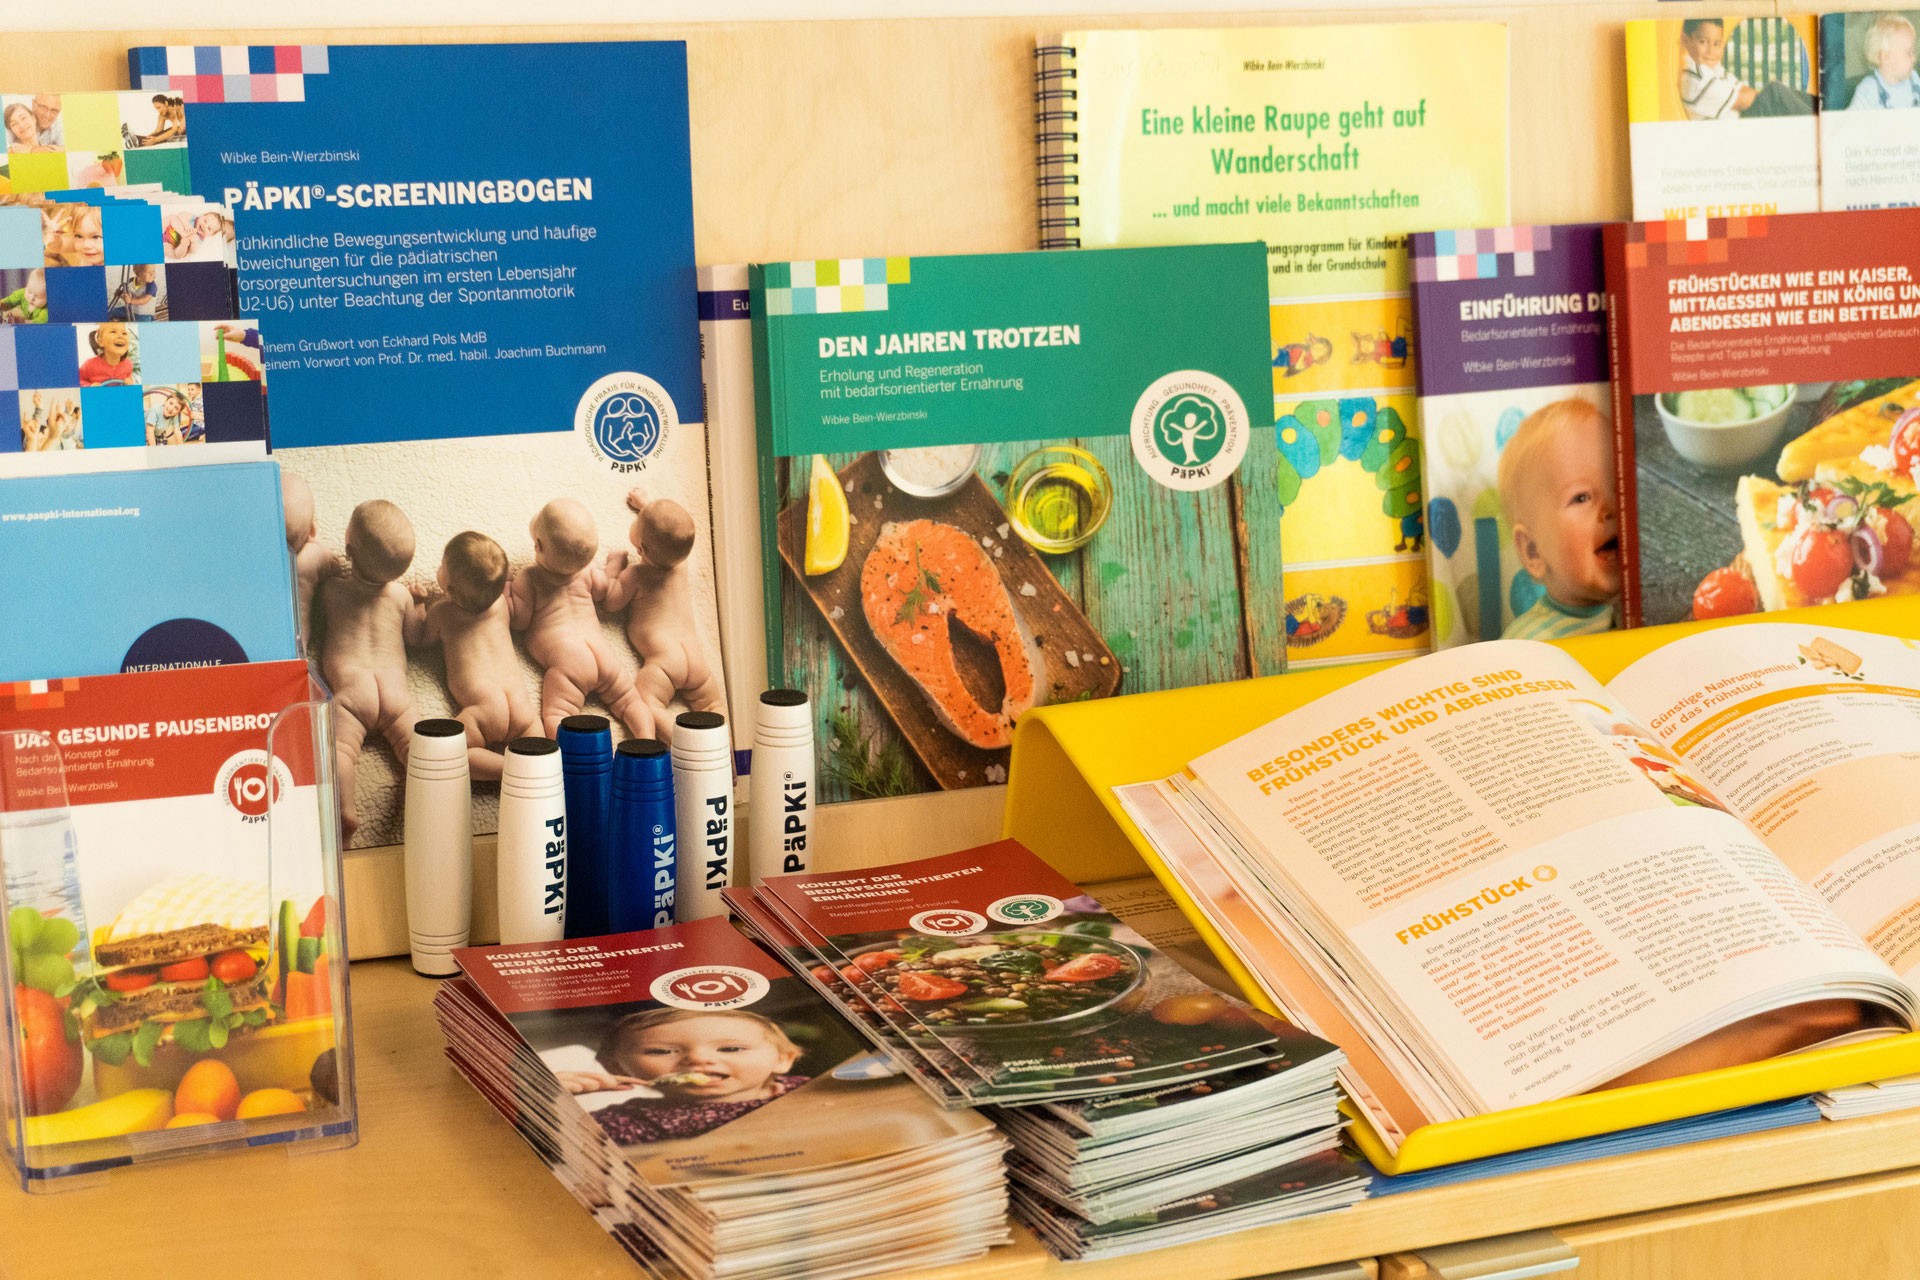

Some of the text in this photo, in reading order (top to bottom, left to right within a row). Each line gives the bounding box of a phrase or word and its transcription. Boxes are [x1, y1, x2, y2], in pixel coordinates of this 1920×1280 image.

[1142, 99, 1425, 138] Eine kleine Raupe geht auf
[220, 150, 360, 164] Wibke Bein-Wierzbinski
[1211, 142, 1360, 175] Wanderschaft
[224, 177, 593, 211] PÄPKI®-SCREENINGBOGEN
[1173, 198, 1200, 217] und
[1206, 196, 1249, 215] macht
[1256, 194, 1291, 213] viele
[1298, 189, 1419, 212] Bekanntschaften
[236, 225, 596, 251] rühkindliche Bewegungsentwicklung und häufige
[1263, 237, 1397, 258] ungsprogramm für Kinder
[236, 248, 497, 273] bweichungen für die pädiatrischen
[1273, 256, 1386, 274] und in der Grundschule
[424, 271, 441, 283] im
[447, 269, 492, 282] ersten
[498, 265, 576, 281] Lebensjahr
[1668, 266, 1912, 294] FRÜHSTÜCKEN WIE EIN KAISER,
[239, 284, 575, 313] U2-U6) unter Beachtung der Spontanmotorik
[732, 299, 750, 311] Eu
[1460, 293, 1583, 321] EINFÜHRUNG
[1669, 292, 1776, 313] MITTAGESSEN
[1779, 290, 1809, 306] WIE
[1813, 288, 1839, 305] EIN
[1843, 285, 1895, 303] KÖNIG
[1670, 312, 1772, 332] ABENDESSEN
[1776, 310, 1804, 326] WIE
[1808, 308, 1834, 324] EIN
[262, 332, 488, 353] einem Grußwort von Eckhard Pols MdB
[819, 324, 1081, 358] DEN JAHREN TROTZEN
[264, 345, 605, 371] einem Vorwort von Prof. Dr. med. habil. Joachim Buchmann
[820, 362, 984, 385] Erholung und Regeneration
[594, 384, 619, 403] PRAXIS
[620, 381, 635, 390] FÜR
[820, 376, 1024, 399] mit bedarfsorientierter Ernährung
[821, 410, 928, 425] Wibke Bein-Wierzbinski
[1142, 382, 1237, 459] AUFRICHTUNG GESUNDHEIT PRÄVENTION
[2, 507, 141, 522] www.paepki-international.org
[1650, 688, 1704, 729] Günstige
[1704, 663, 1799, 694] Nahrungsmittel
[1658, 679, 1766, 740] für das Frühstück
[57, 722, 151, 746] GESUNDE
[1245, 669, 1523, 784] BESONDERS WICHTIG SIND
[1257, 679, 1577, 797] FRÜHSTÜCK UND ABENDESSEN
[1678, 709, 1741, 751] Nahrungsmittel
[15, 754, 39, 764] Nach
[64, 749, 102, 761] Konzept
[105, 748, 121, 757] der
[16, 757, 155, 777] Bedarfsoentierten Ernährung
[17, 780, 119, 798] Wibke Bei-Wierzbinski
[783, 771, 807, 873] PäPKi®
[1755, 807, 1781, 831] Wiener
[1762, 808, 1800, 838] Leberkäse
[544, 815, 565, 924] PäPKi®
[797, 873, 902, 890] KONZEPT DER
[803, 865, 984, 896] BEDARFSORIENTIERTEN
[1813, 871, 1835, 890] Fisch:
[811, 887, 910, 903] ERNÄHRUNG
[1394, 875, 1534, 945] FRÜHSTÜCK
[485, 945, 600, 962] KONZEPT DER
[491, 942, 685, 969] BEDARFSORIENTIERTEN
[499, 960, 604, 976] ERNÄHRUNG
